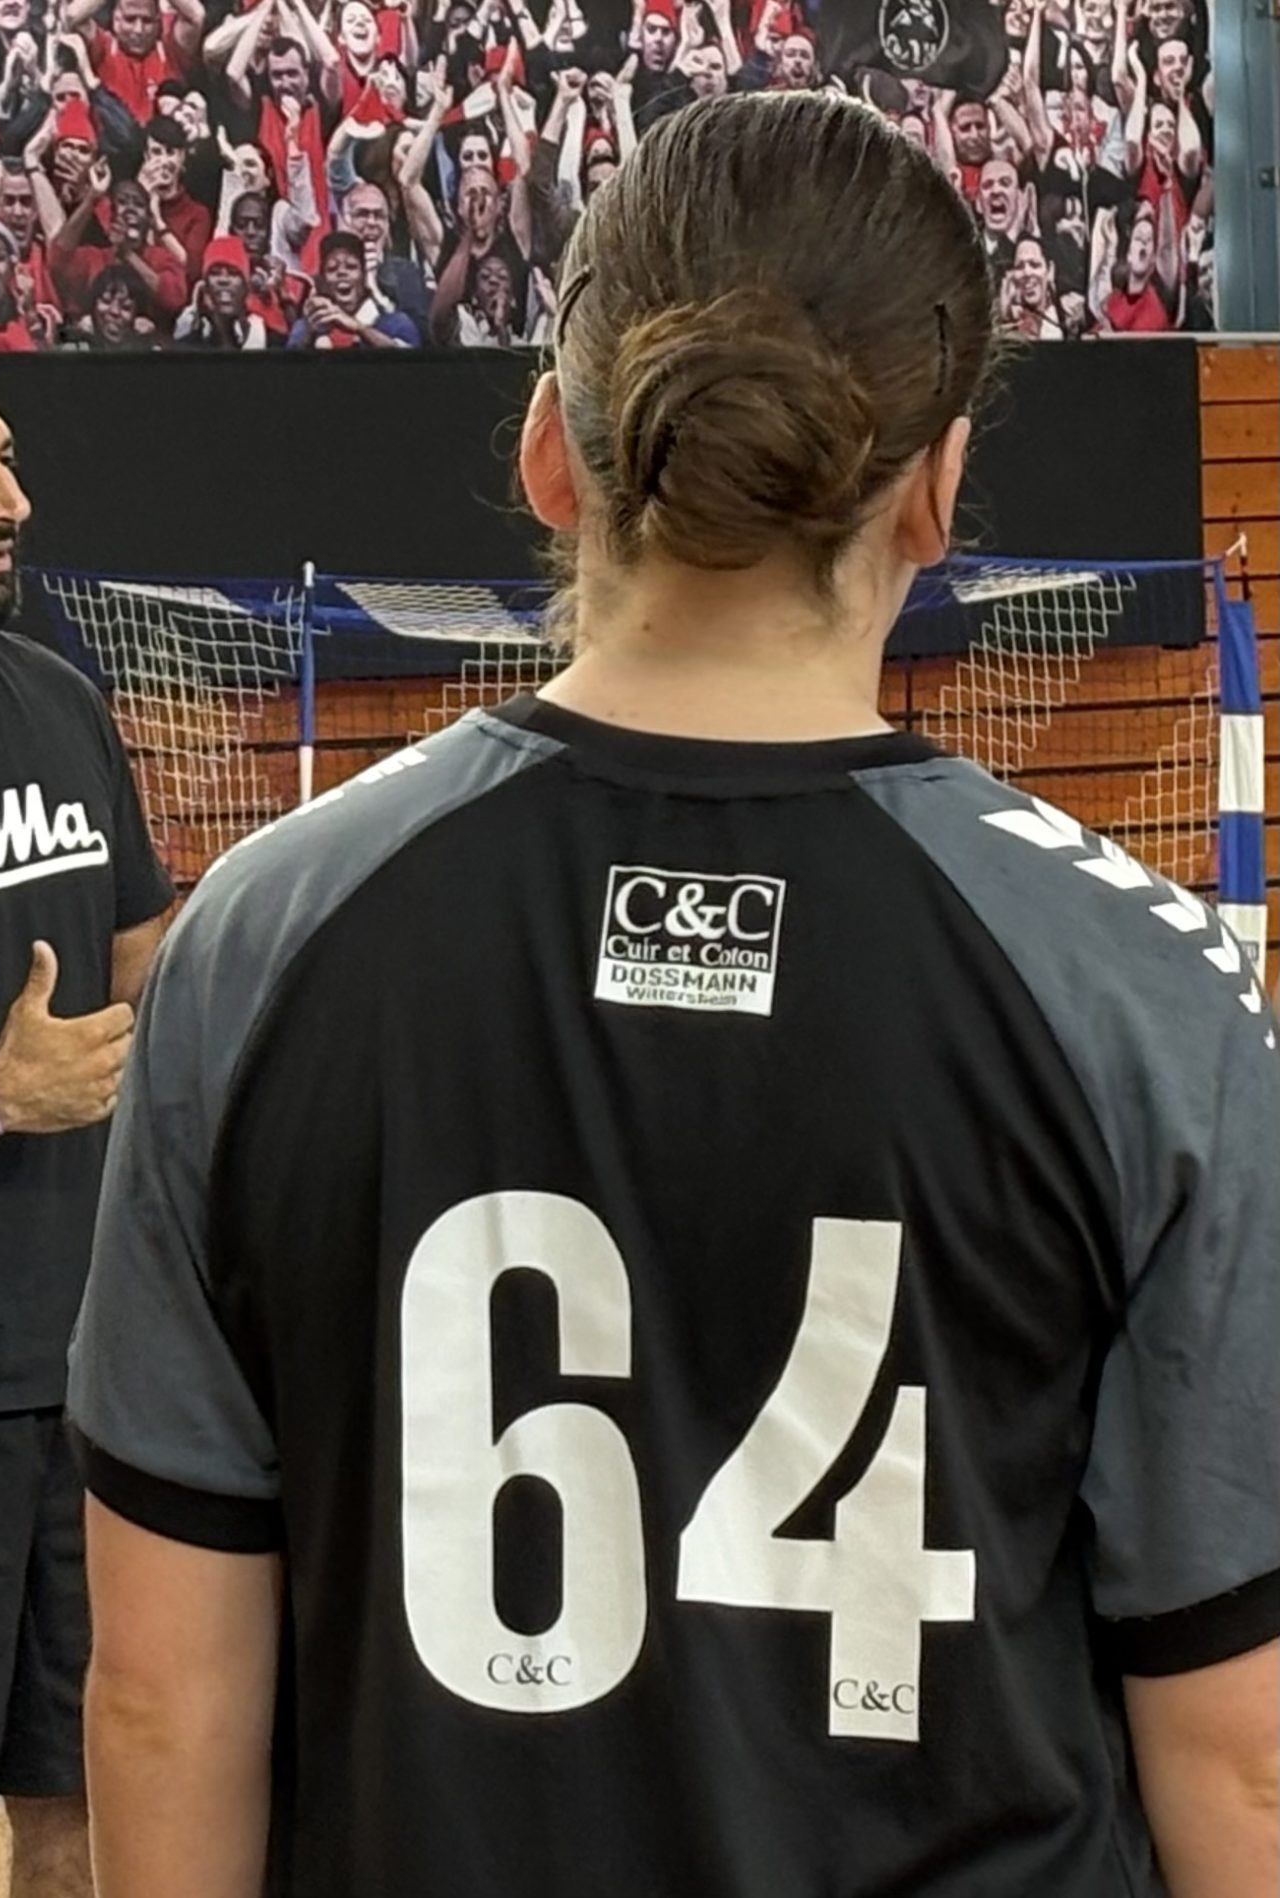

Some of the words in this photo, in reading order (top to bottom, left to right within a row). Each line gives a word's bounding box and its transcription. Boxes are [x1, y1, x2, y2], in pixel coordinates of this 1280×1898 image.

[614, 876, 775, 941] C&C
[606, 935, 662, 962] Cuir
[667, 943, 692, 963] et
[610, 963, 758, 994] DOSSMANN
[401, 1189, 976, 1742] 64
[486, 1652, 573, 1687] C&C
[833, 1678, 916, 1715] C&C
